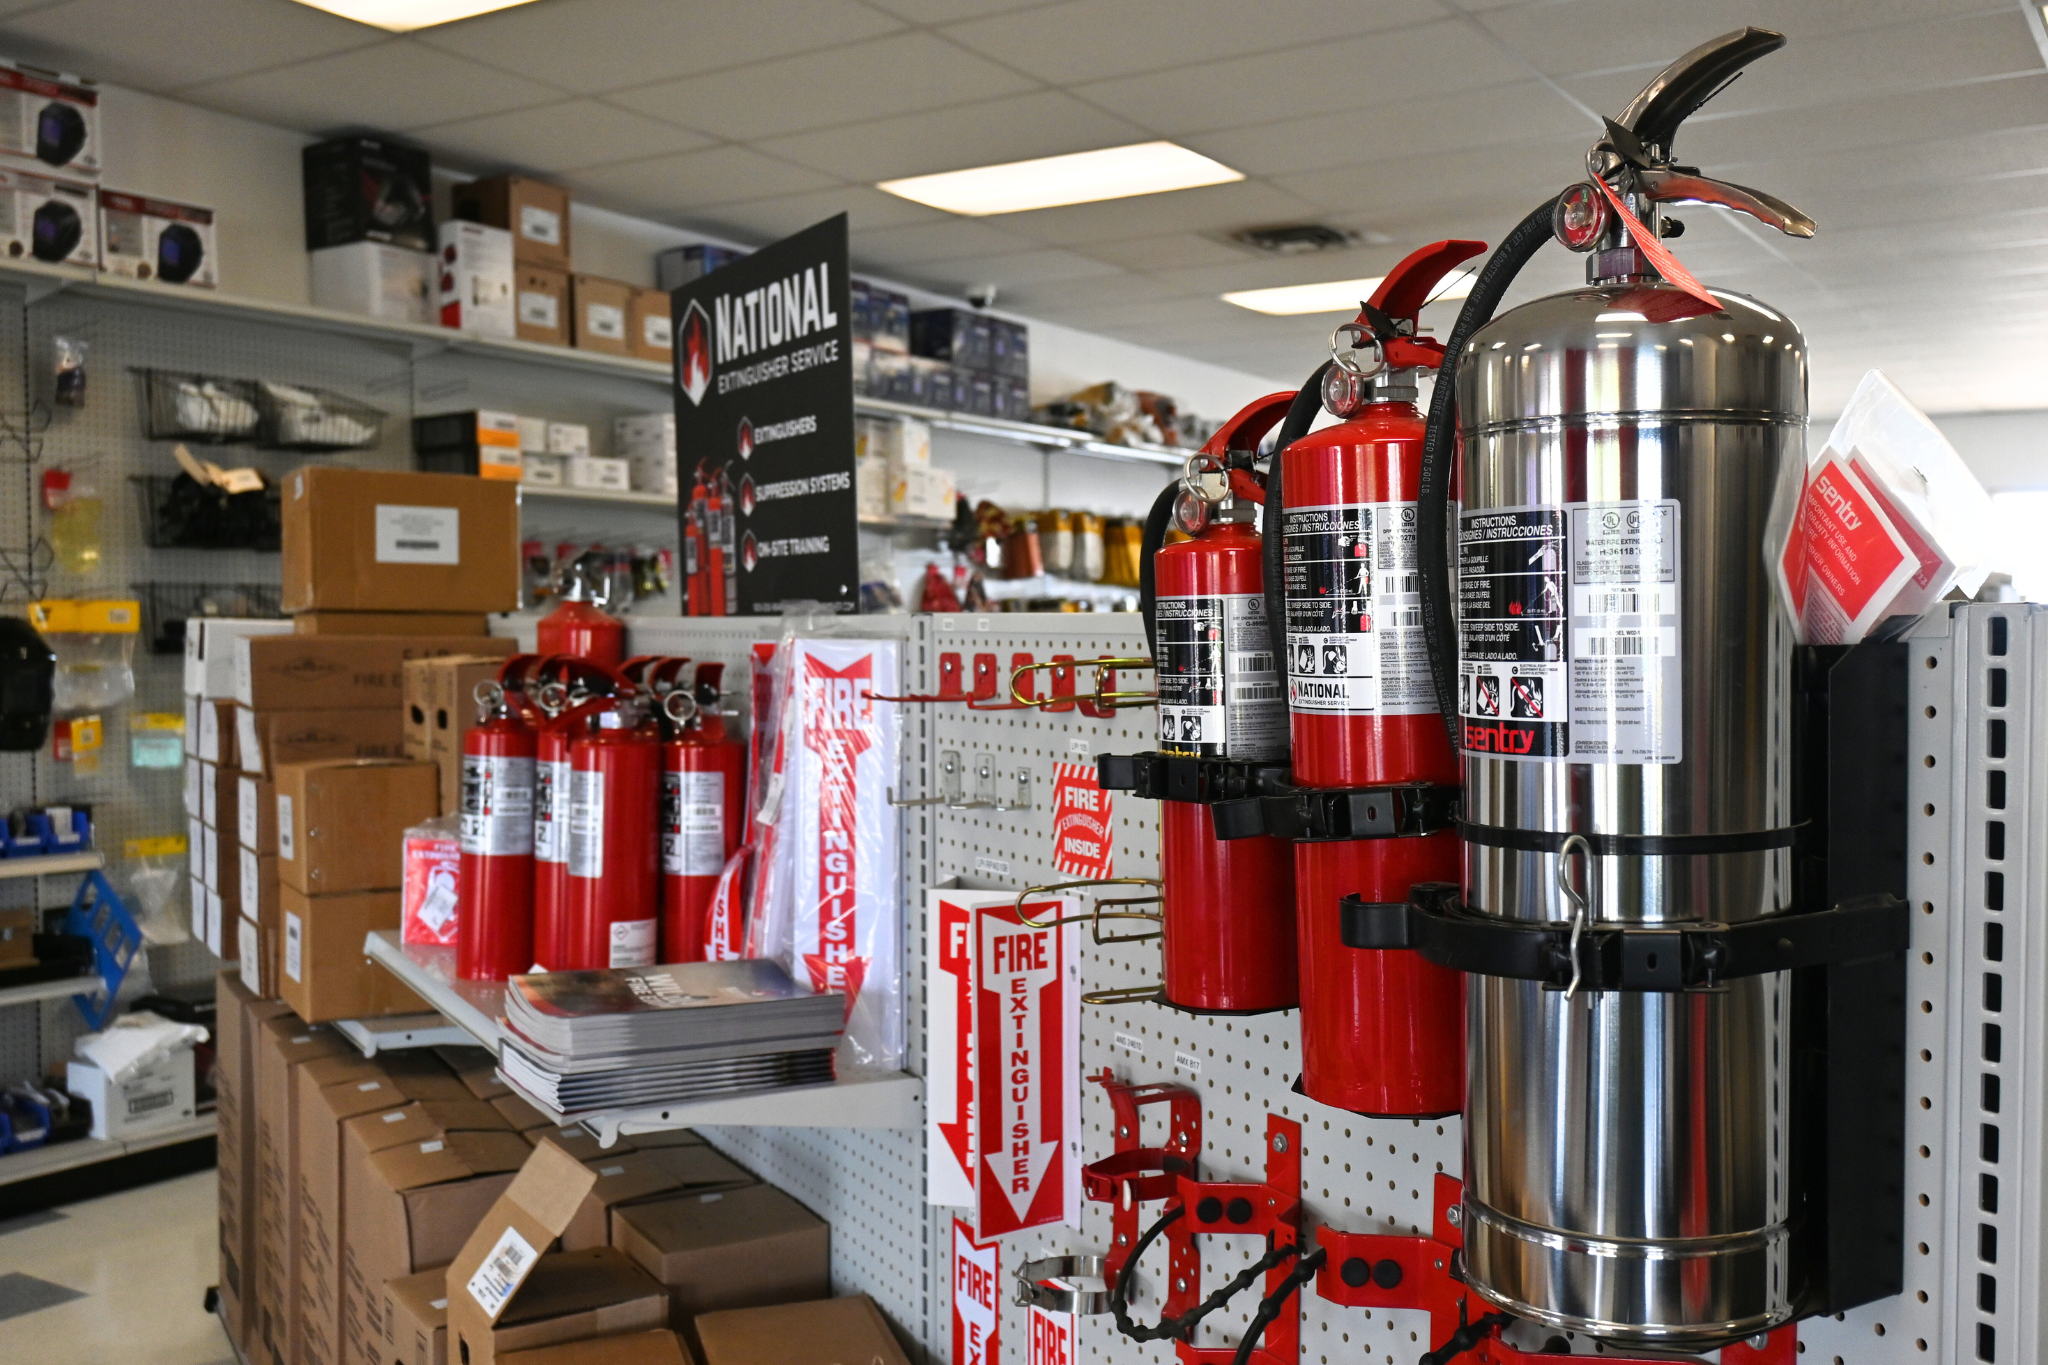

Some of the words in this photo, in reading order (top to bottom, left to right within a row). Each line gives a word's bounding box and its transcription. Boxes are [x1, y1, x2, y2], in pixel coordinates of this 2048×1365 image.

[1510, 230, 1524, 245] EXT.
[1522, 218, 1537, 233] FIRE
[1504, 243, 1513, 253] &
[1482, 251, 1507, 283] BOOSTER
[1473, 282, 1486, 304] HOSE
[715, 262, 838, 365] NATIONAL
[1464, 306, 1475, 322] 250
[1458, 324, 1469, 337] PSI
[718, 355, 789, 395] EXTINGUISHER
[791, 340, 839, 373] SERVICE
[1442, 337, 1462, 375] WORKING
[1432, 375, 1449, 415] PRESSURE
[754, 415, 817, 445] EXTINGUISHERS
[1426, 425, 1438, 452] TESTED
[1424, 455, 1433, 464] TO
[755, 479, 809, 502] SUPPRESSION
[810, 471, 851, 493] SYSTEMS
[1423, 466, 1432, 482] 500
[1421, 485, 1430, 497] LB.
[1815, 475, 1862, 531] sentry
[1271, 499, 1282, 531] PRESSURE
[1290, 513, 1328, 523] INSTRUCTIONS
[1302, 521, 1360, 533] INSTRUCCIONES
[1471, 515, 1517, 529] INSTRUCTIONS
[1486, 525, 1553, 539] INSTRUCCIONES
[757, 541, 789, 558] ON-SITE
[790, 536, 830, 554] TRAINING
[1271, 533, 1281, 563] WORKING
[1835, 529, 1846, 547] USE
[1844, 545, 1857, 562] AND
[1827, 539, 1861, 585] INFORMATION
[1474, 581, 1480, 589] OF
[1822, 564, 1845, 596] OWNERS
[1165, 609, 1213, 618] INSTRUCCIONES
[1484, 623, 1496, 631] SIDE
[1496, 623, 1504, 631] TO
[1505, 623, 1520, 631] SIDE.
[1496, 632, 1510, 641] CÔTÉ
[1298, 681, 1350, 698] NATIONAL
[1439, 689, 1452, 714] LISTED
[804, 677, 872, 730] FIRE
[1466, 722, 1535, 753] sentry
[1064, 786, 1099, 812] FIRE
[1062, 813, 1104, 838] EXTINGUISHER
[1064, 837, 1101, 859] INSIDE
[824, 740, 848, 987] EXTINGUISHE
[993, 932, 1048, 974] FIRE
[1176, 1055, 1189, 1066] AMX
[1010, 978, 1030, 1194] EXTINGUISHER
[958, 1254, 993, 1311] FIRE
[1033, 1310, 1067, 1365] FIRE
